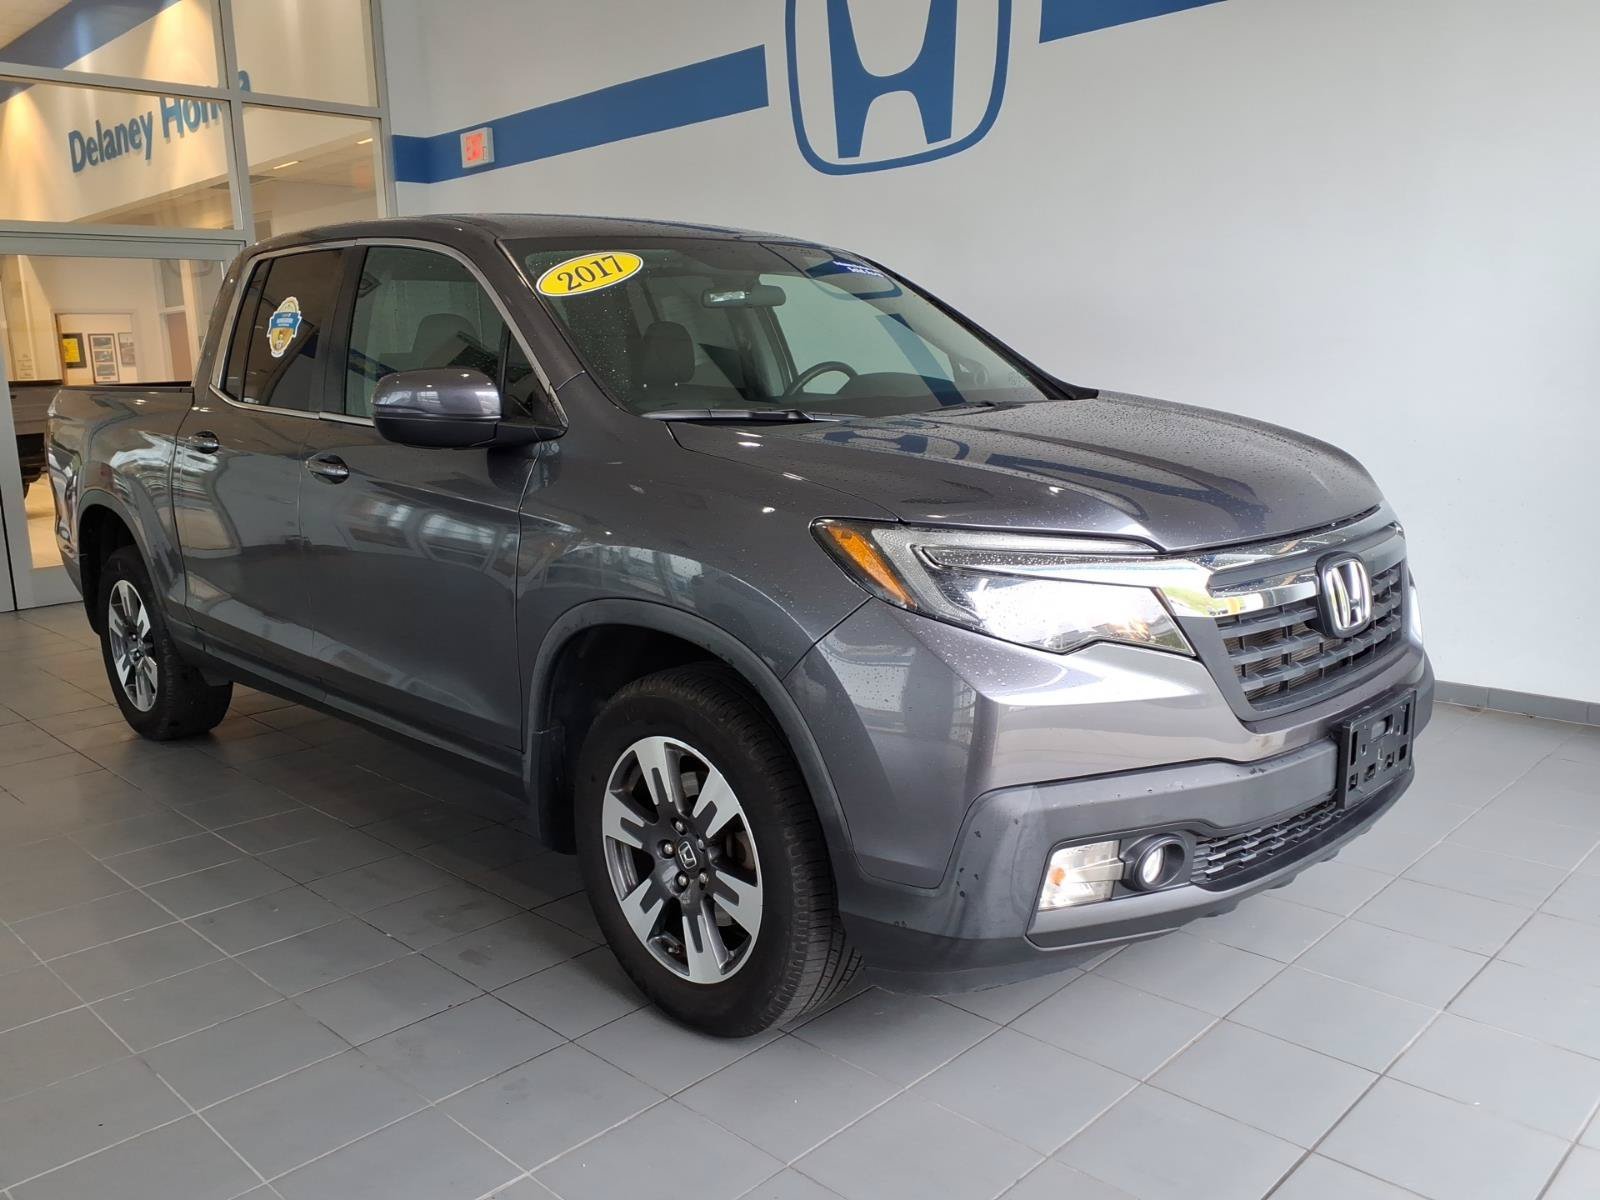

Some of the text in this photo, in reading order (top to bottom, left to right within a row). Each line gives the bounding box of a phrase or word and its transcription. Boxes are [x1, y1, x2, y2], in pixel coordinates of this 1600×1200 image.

[68, 70, 250, 173] Delaney Hon
[557, 255, 623, 291] 2017
